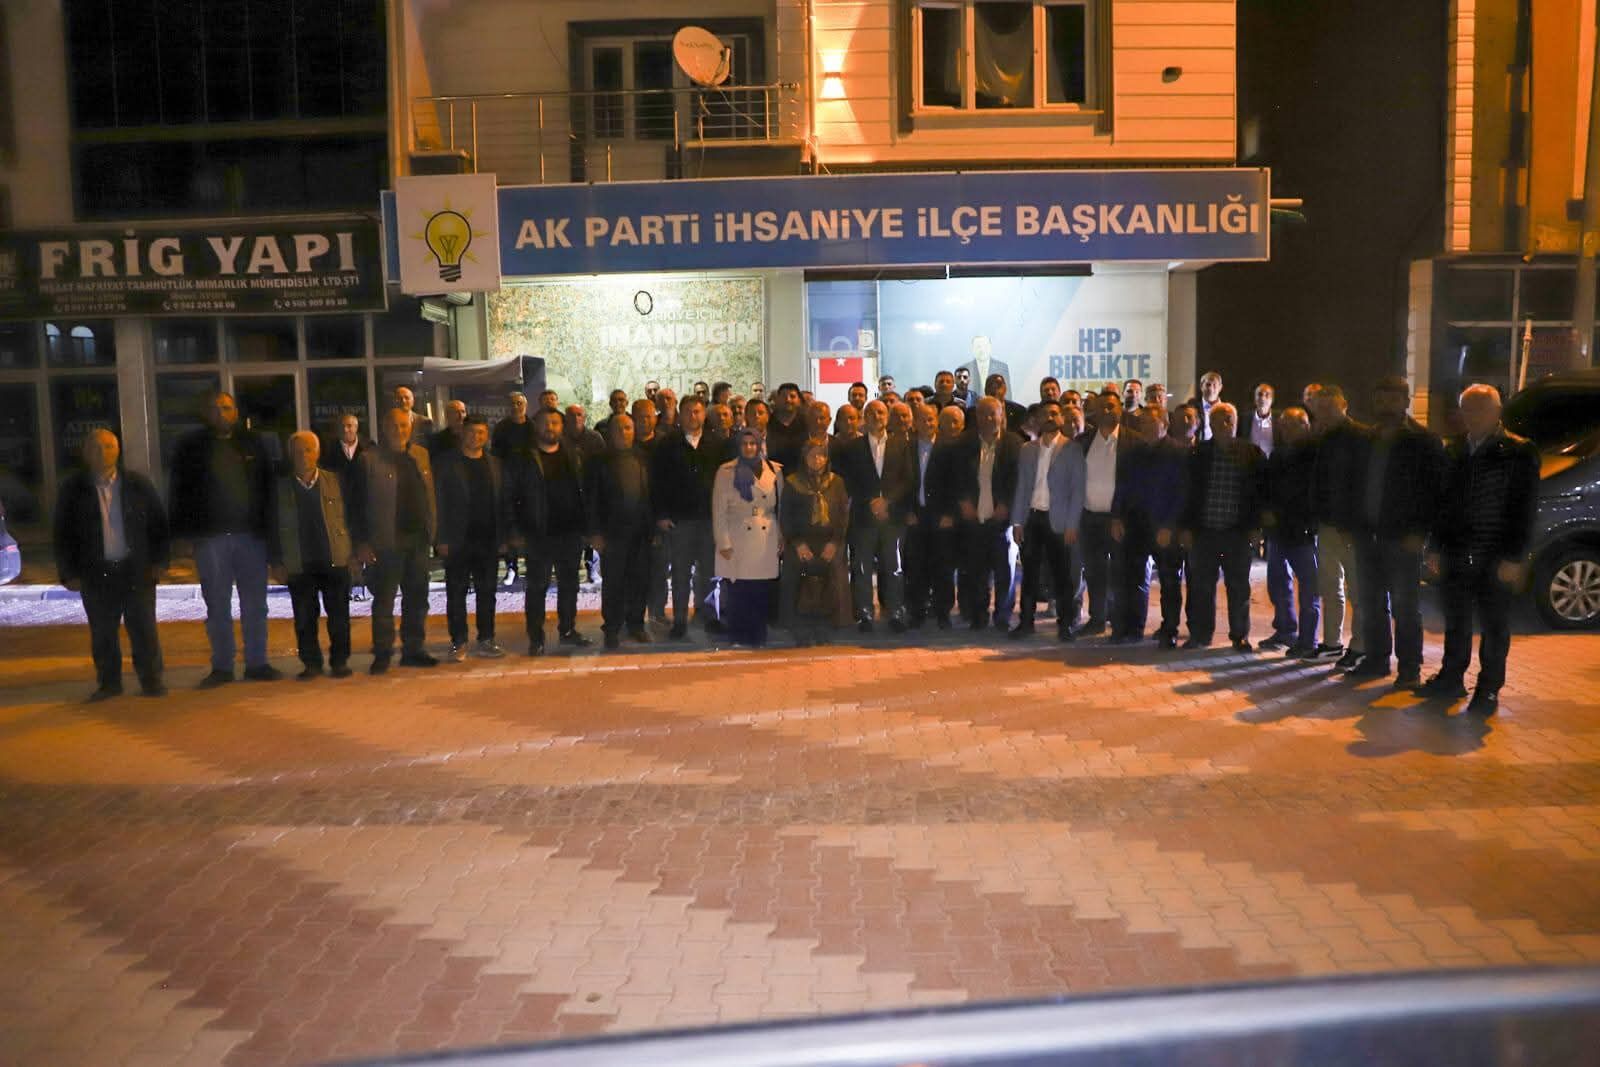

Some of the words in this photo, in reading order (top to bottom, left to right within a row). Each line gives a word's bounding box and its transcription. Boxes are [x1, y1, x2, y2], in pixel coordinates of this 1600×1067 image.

[515, 218, 573, 250] AK
[1016, 193, 1260, 243] BAŞKANLIĞI
[207, 232, 357, 276] YAPI
[1078, 327, 1121, 353] HEP
